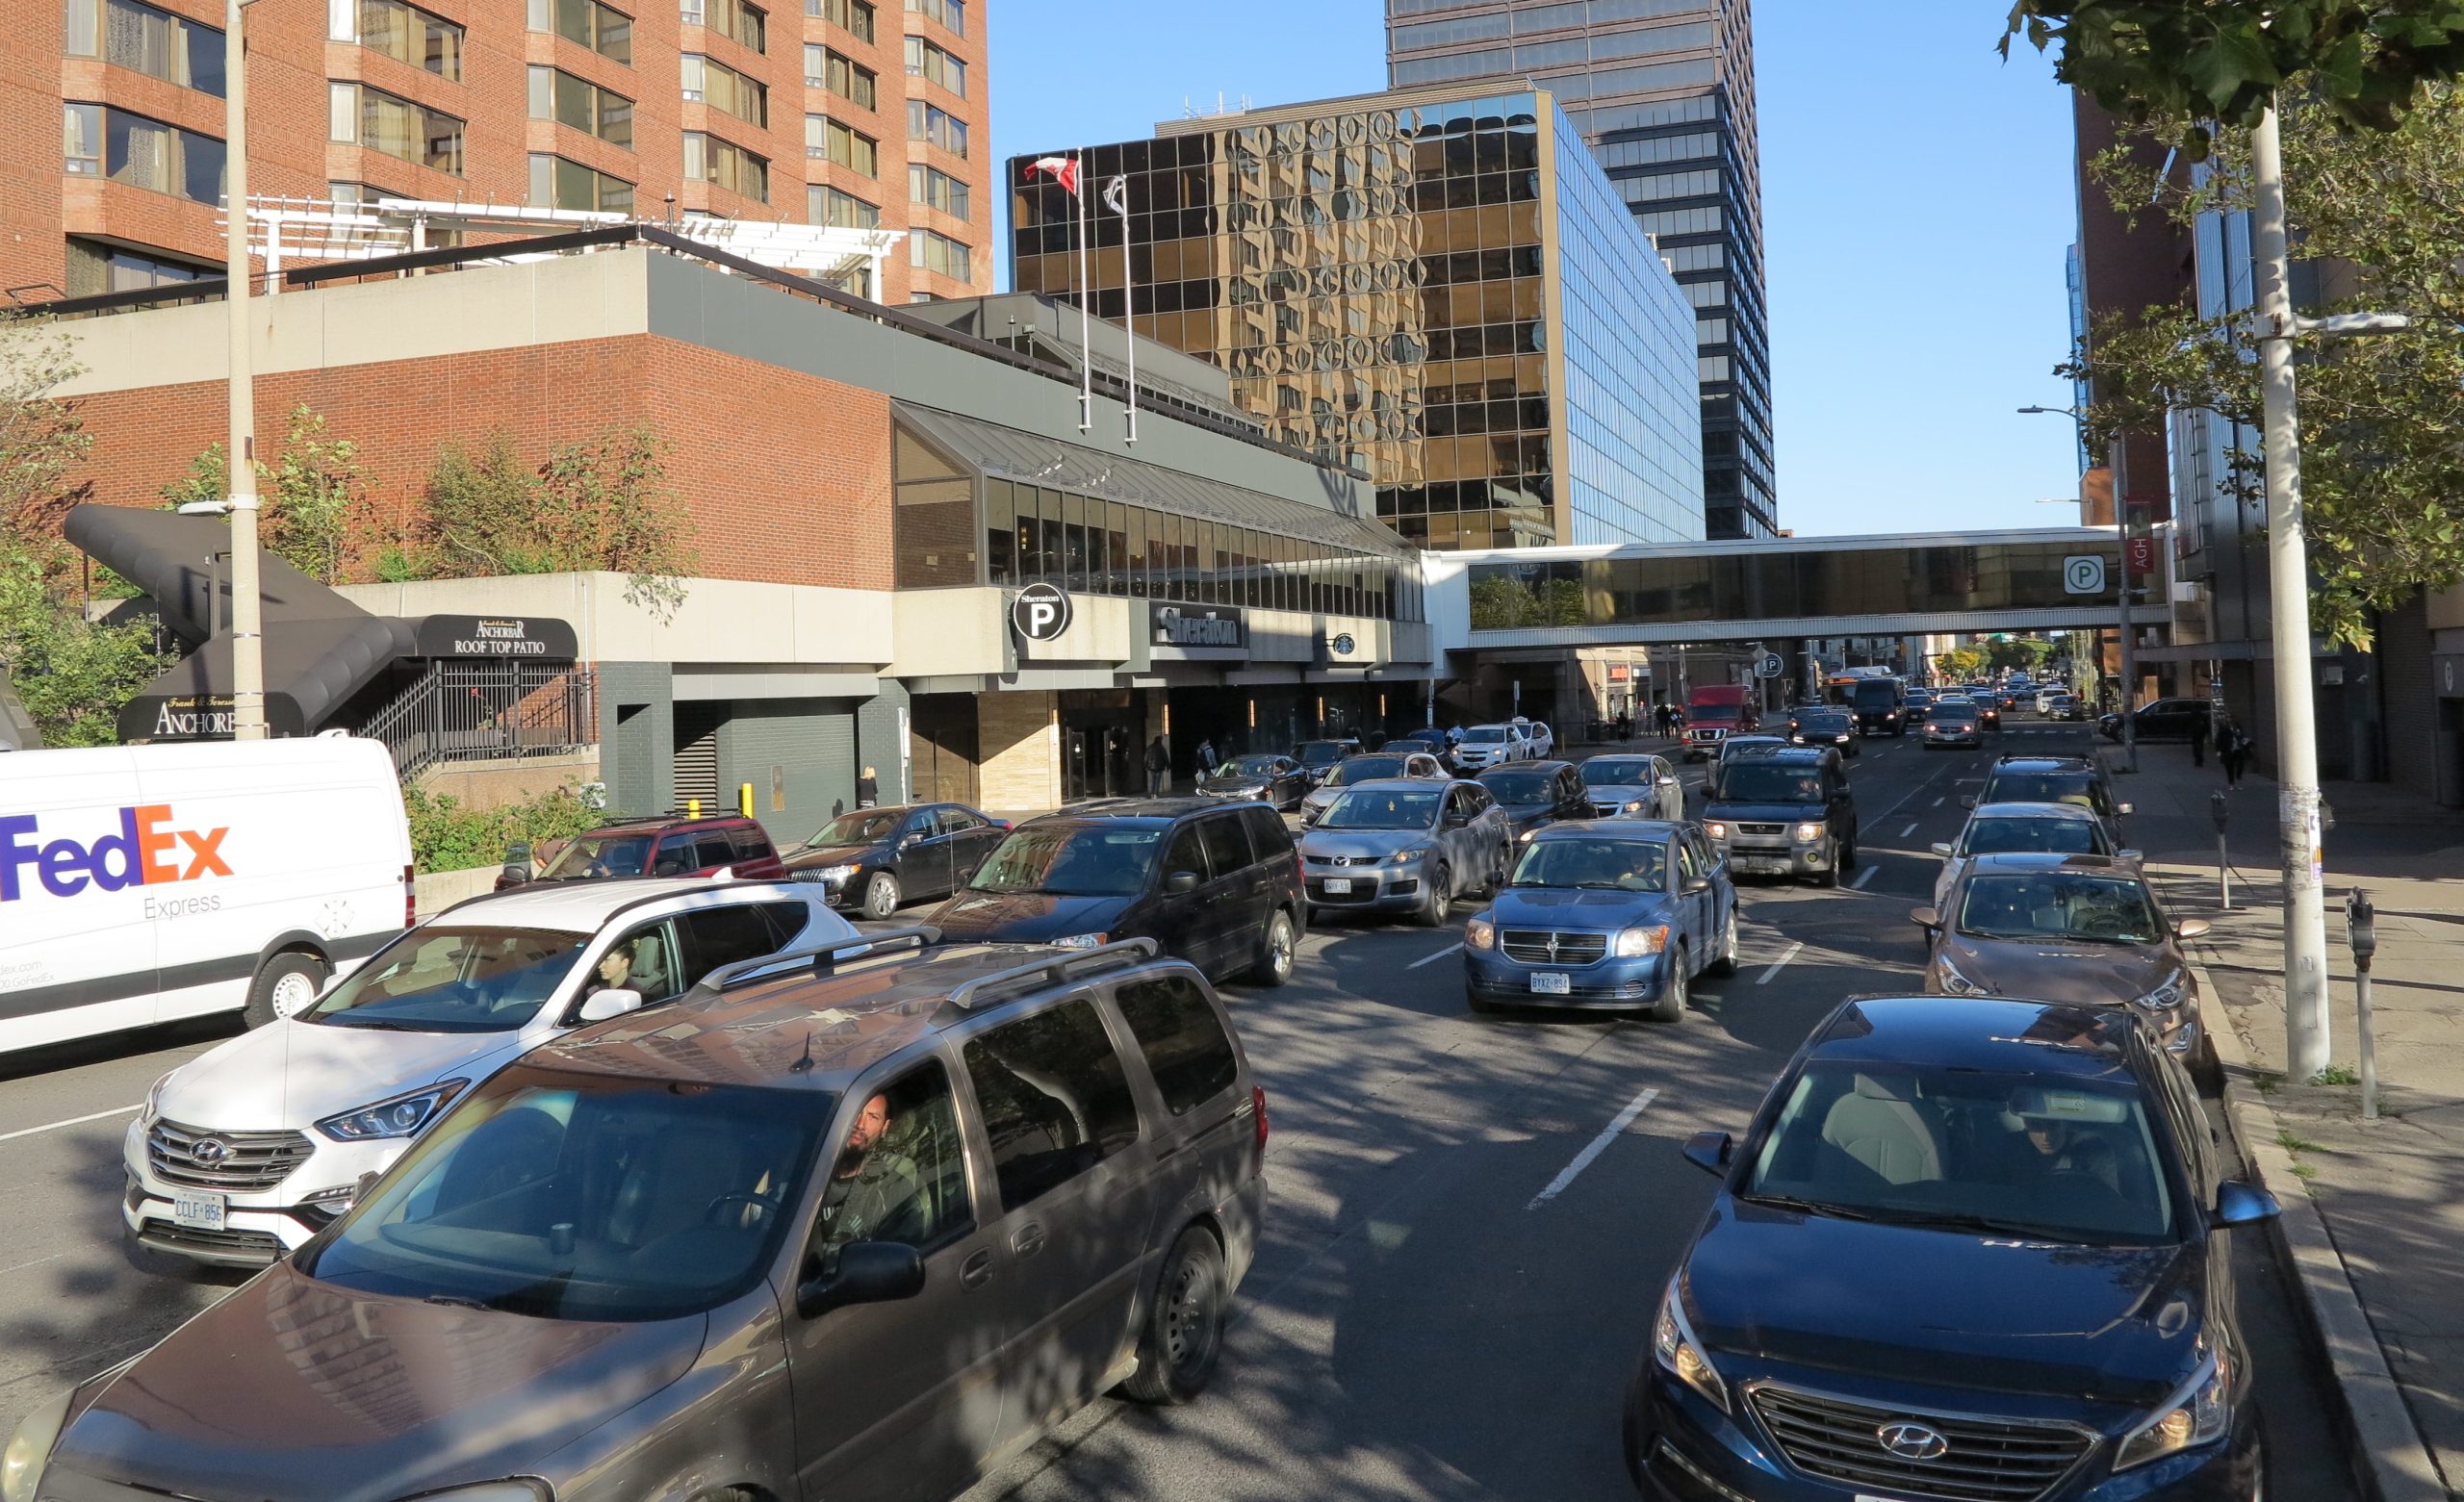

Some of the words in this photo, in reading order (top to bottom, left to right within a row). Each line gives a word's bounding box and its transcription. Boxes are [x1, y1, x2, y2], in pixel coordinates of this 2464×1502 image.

[2135, 538, 2147, 568] AGH
[2078, 566, 2092, 584] P
[1020, 595, 1060, 603] Sheraton
[1031, 602, 1055, 637] P
[1156, 606, 1239, 645] Sheraton
[454, 640, 487, 653] ROOF
[489, 641, 512, 654] TOP
[513, 641, 546, 654] PATIO
[1769, 661, 1777, 670] P
[167, 697, 195, 708] Frank
[154, 701, 235, 734] ANCHORB
[0, 803, 235, 903] FedEx
[144, 894, 221, 921] Express
[176, 1200, 199, 1219] CCLF
[204, 1203, 222, 1222] 856
